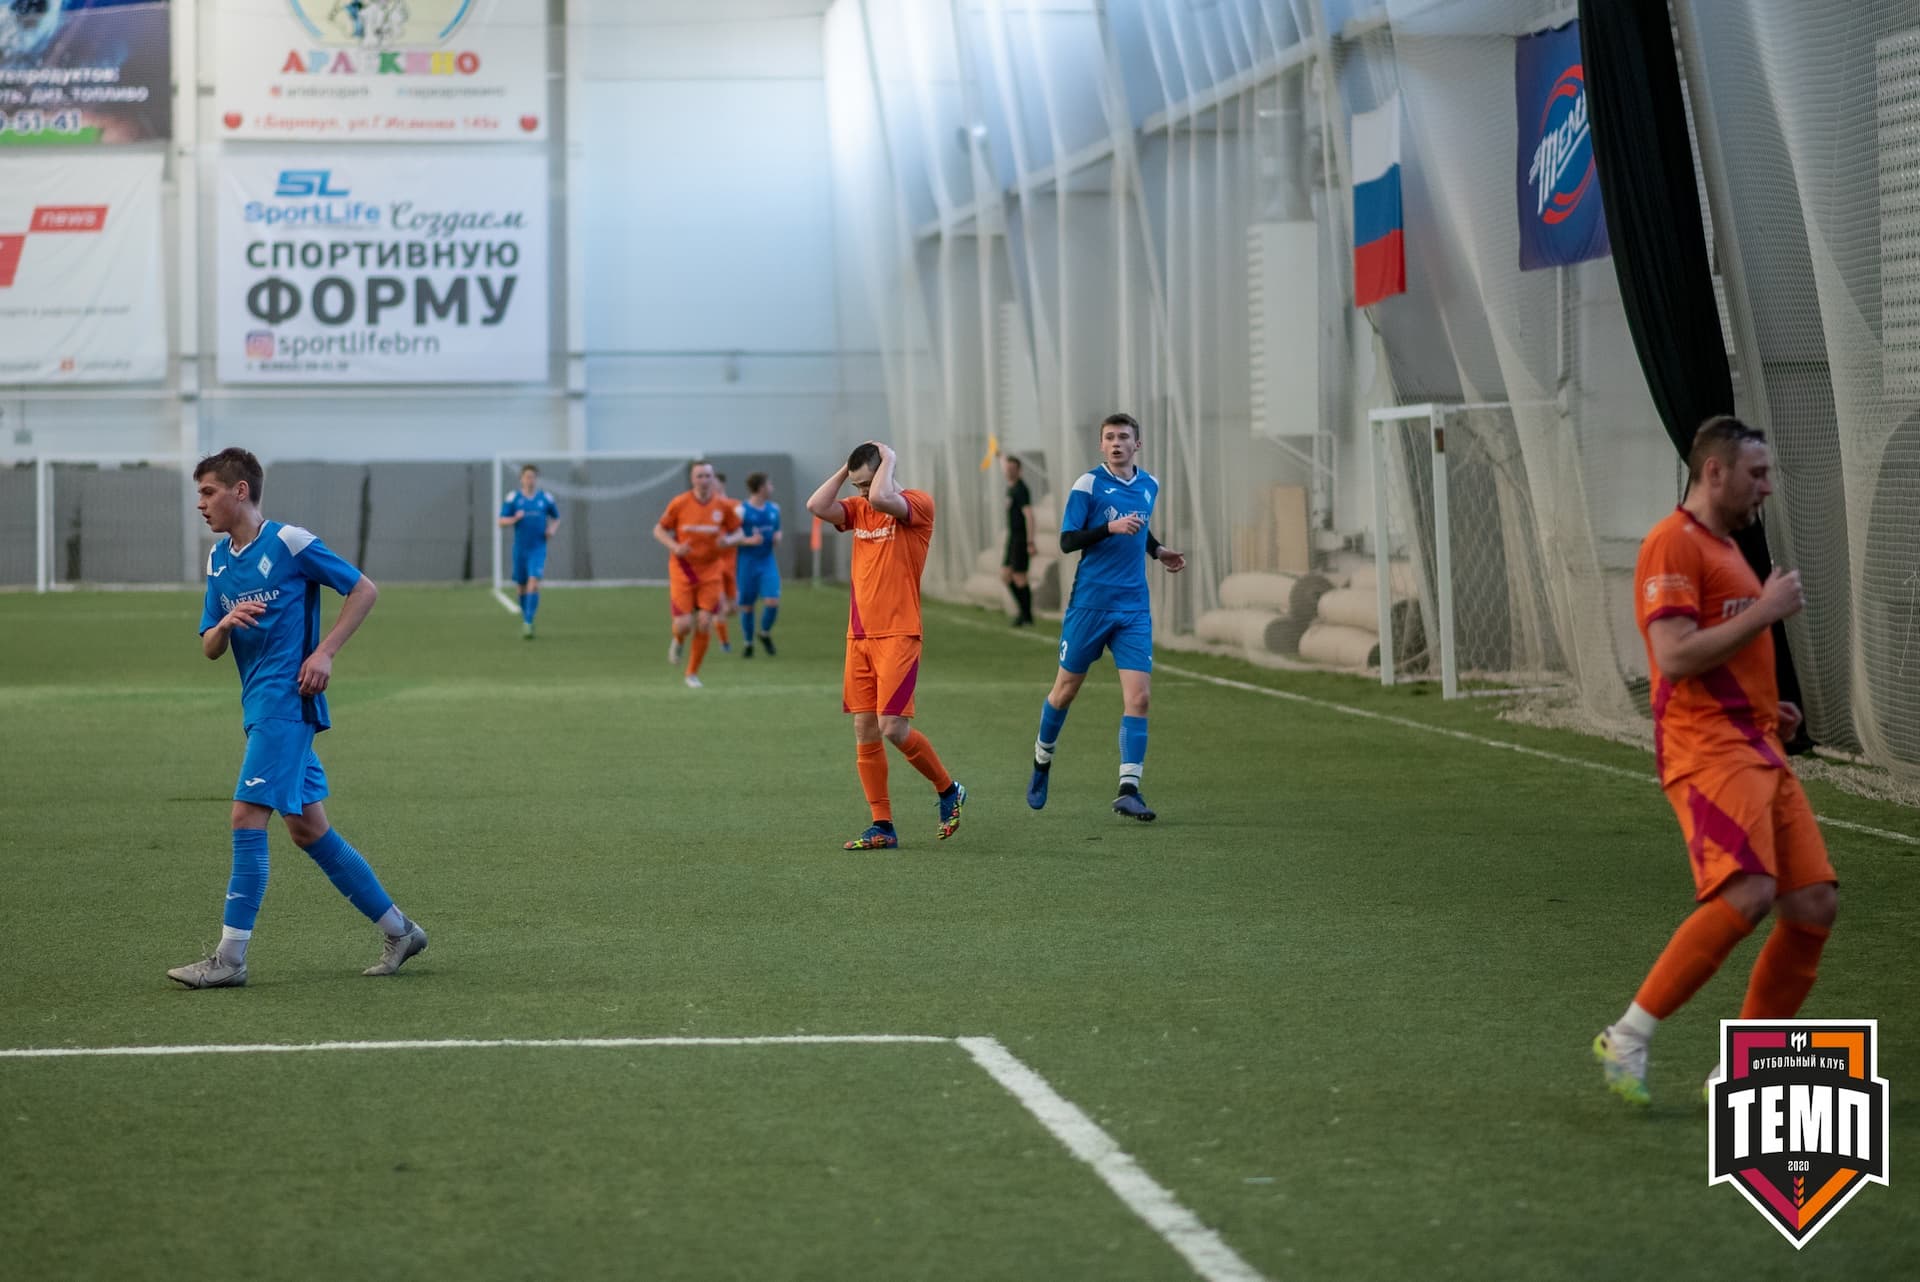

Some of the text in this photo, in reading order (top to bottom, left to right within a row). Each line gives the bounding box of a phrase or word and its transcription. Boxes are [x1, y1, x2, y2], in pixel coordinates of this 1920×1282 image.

[274, 169, 351, 197] SL
[41, 210, 97, 226] news
[244, 201, 381, 225] SportLife
[390, 200, 527, 238] Создаем
[245, 241, 520, 269] СПОРТИВНУЮ
[246, 276, 518, 327] ФОРМУ
[278, 332, 440, 357] sportlifebrn
